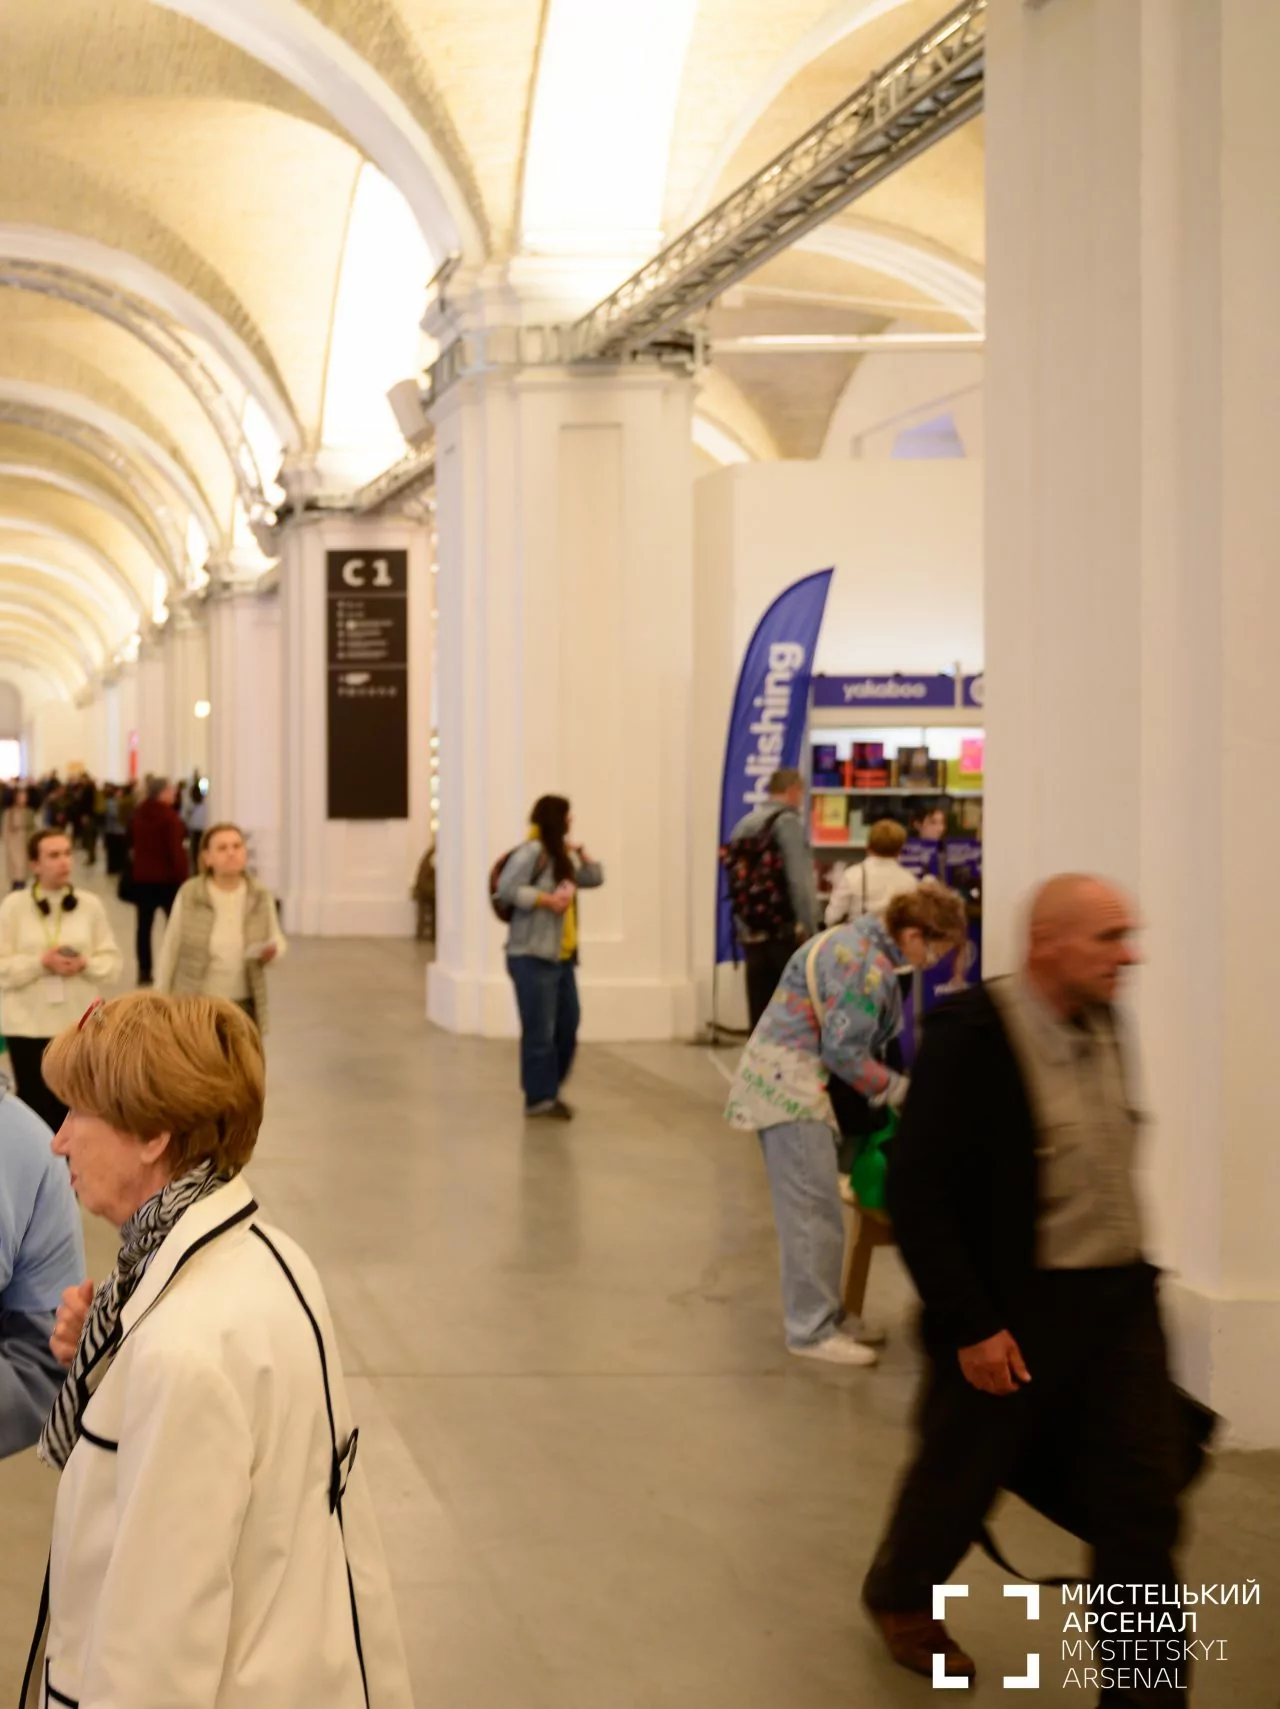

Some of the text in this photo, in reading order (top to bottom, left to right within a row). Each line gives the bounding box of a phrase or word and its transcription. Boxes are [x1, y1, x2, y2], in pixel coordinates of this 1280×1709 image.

[342, 558, 393, 588] C1
[842, 679, 928, 703] yakaboo
[742, 641, 805, 808] blishing
